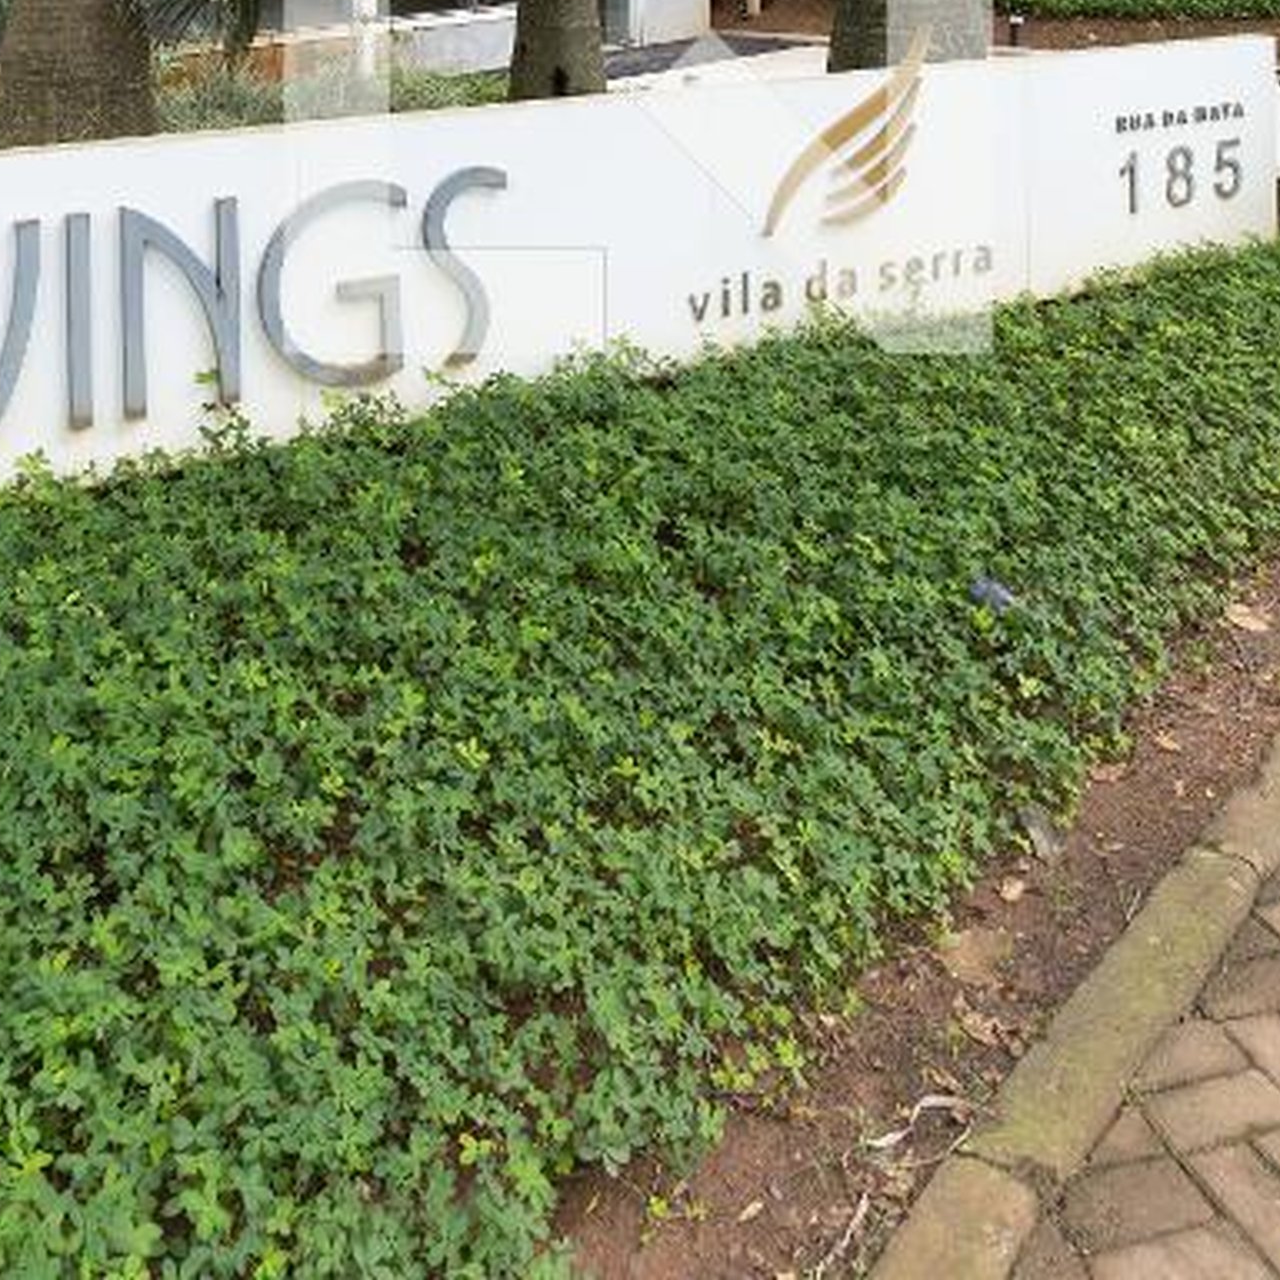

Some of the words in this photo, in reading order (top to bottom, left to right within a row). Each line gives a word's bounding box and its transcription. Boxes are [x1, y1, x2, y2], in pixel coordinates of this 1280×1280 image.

[1115, 111, 1155, 134] RUA
[1162, 110, 1188, 128] DA
[1119, 137, 1242, 214] 185
[688, 271, 783, 323] vila
[805, 258, 858, 303] da
[878, 244, 993, 293] serra
